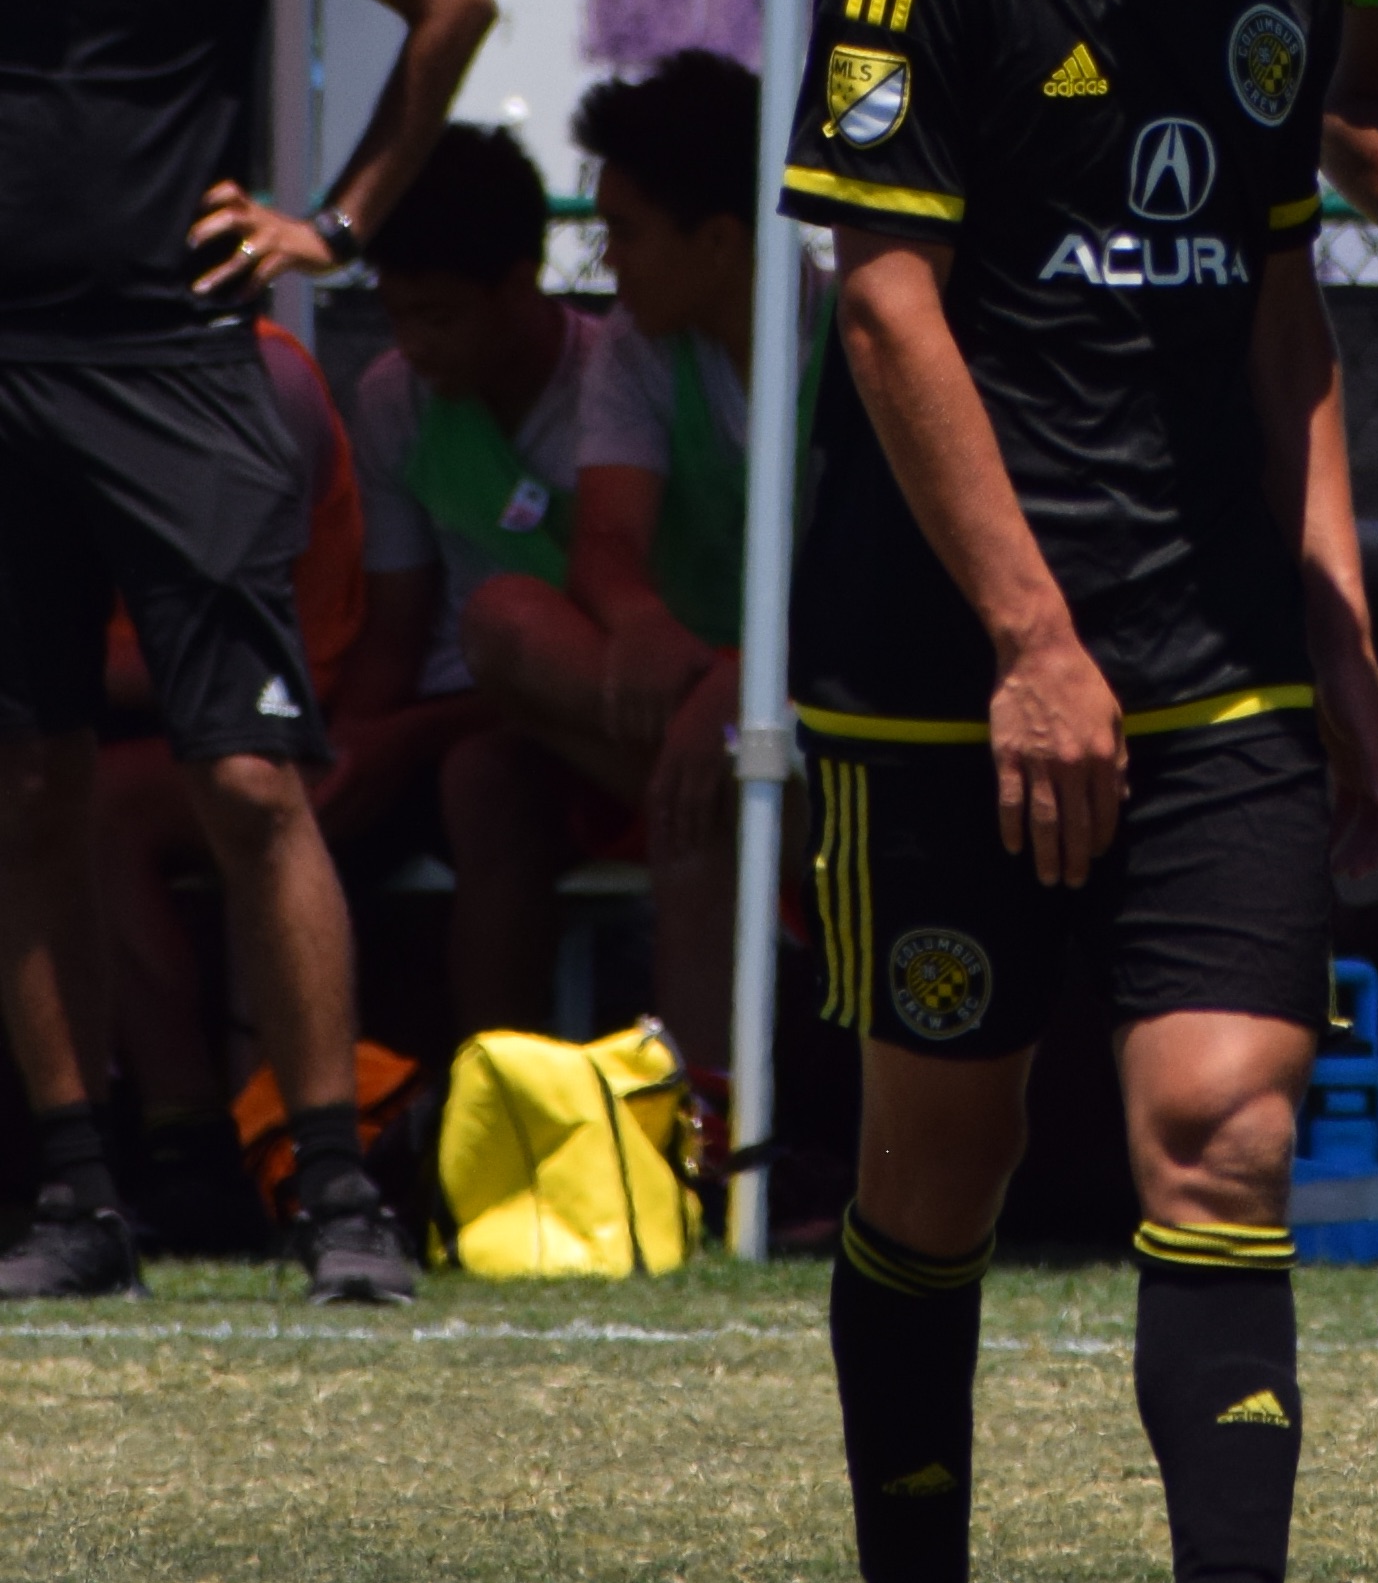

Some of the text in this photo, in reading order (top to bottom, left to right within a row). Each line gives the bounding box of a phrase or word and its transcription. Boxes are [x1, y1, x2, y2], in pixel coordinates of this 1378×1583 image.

[1238, 17, 1300, 57] COLUMBUS
[834, 57, 873, 83] MLS
[1043, 77, 1109, 98] adidas
[1243, 78, 1279, 114] CREW
[1038, 234, 1250, 287] ACURA
[897, 937, 981, 976] COLUMBUS
